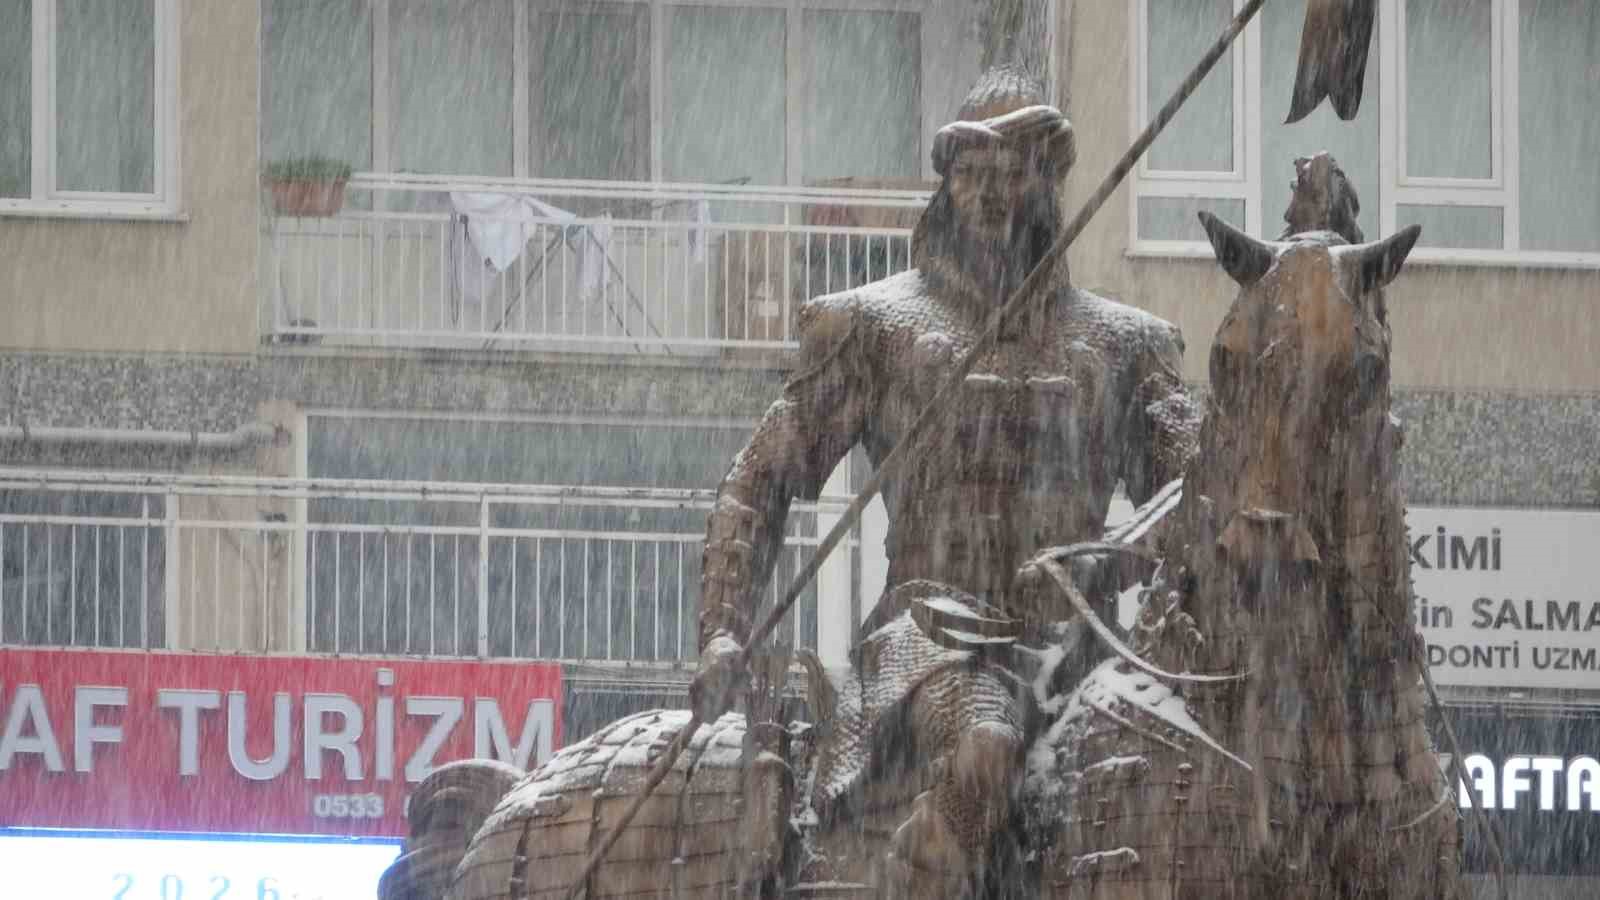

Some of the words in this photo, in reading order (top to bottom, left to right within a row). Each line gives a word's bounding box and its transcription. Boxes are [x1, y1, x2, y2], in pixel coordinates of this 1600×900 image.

[1427, 640, 1520, 668] DONTİ
[1532, 647, 1600, 671] UZM
[0, 682, 129, 772] AF
[157, 668, 555, 782] TURİZM
[314, 794, 384, 818] 0533
